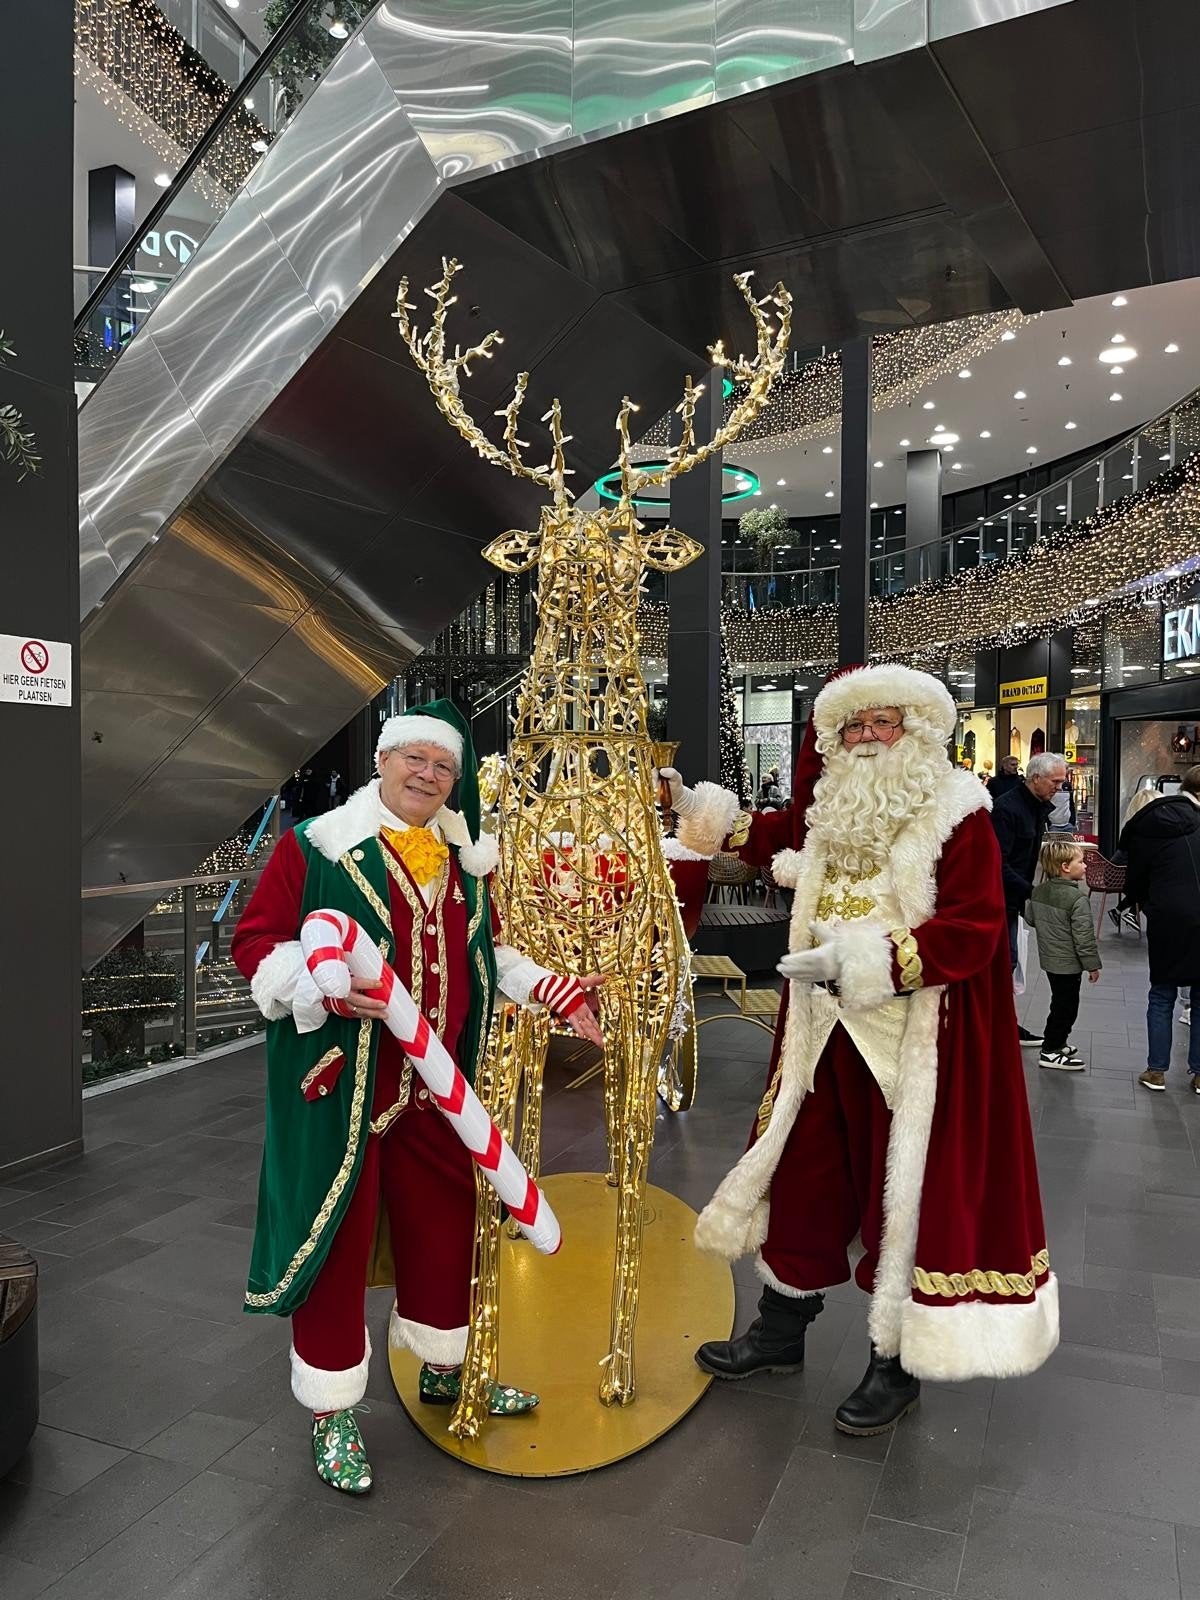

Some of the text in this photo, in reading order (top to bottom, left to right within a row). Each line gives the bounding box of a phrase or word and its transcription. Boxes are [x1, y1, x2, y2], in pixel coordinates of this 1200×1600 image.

[3, 674, 66, 689] HIER GEEN FIETSEN
[18, 690, 52, 701] PLAATSEN
[1002, 683, 1044, 698] BRAND OUTLET
